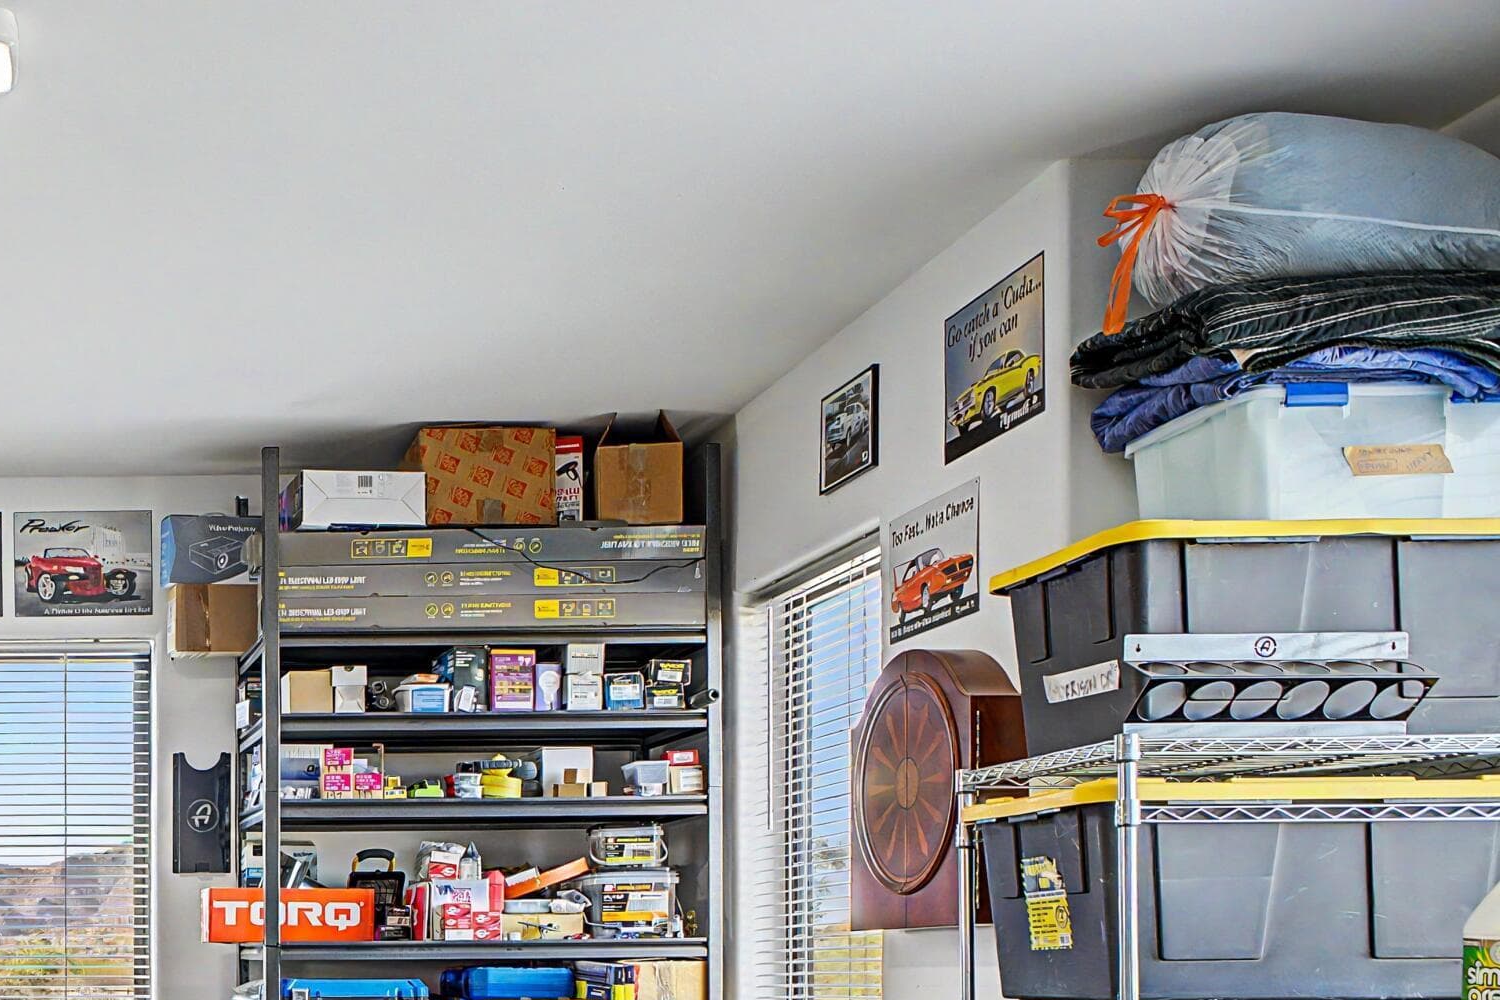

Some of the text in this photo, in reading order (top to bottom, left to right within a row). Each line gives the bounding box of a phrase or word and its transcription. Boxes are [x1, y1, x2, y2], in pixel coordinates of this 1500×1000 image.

[947, 324, 962, 348] Go
[963, 303, 990, 337] catch
[991, 301, 999, 317] a
[977, 328, 997, 358] you
[999, 313, 1018, 338] can
[891, 531, 904, 548] Too
[213, 900, 360, 932] TORQ
